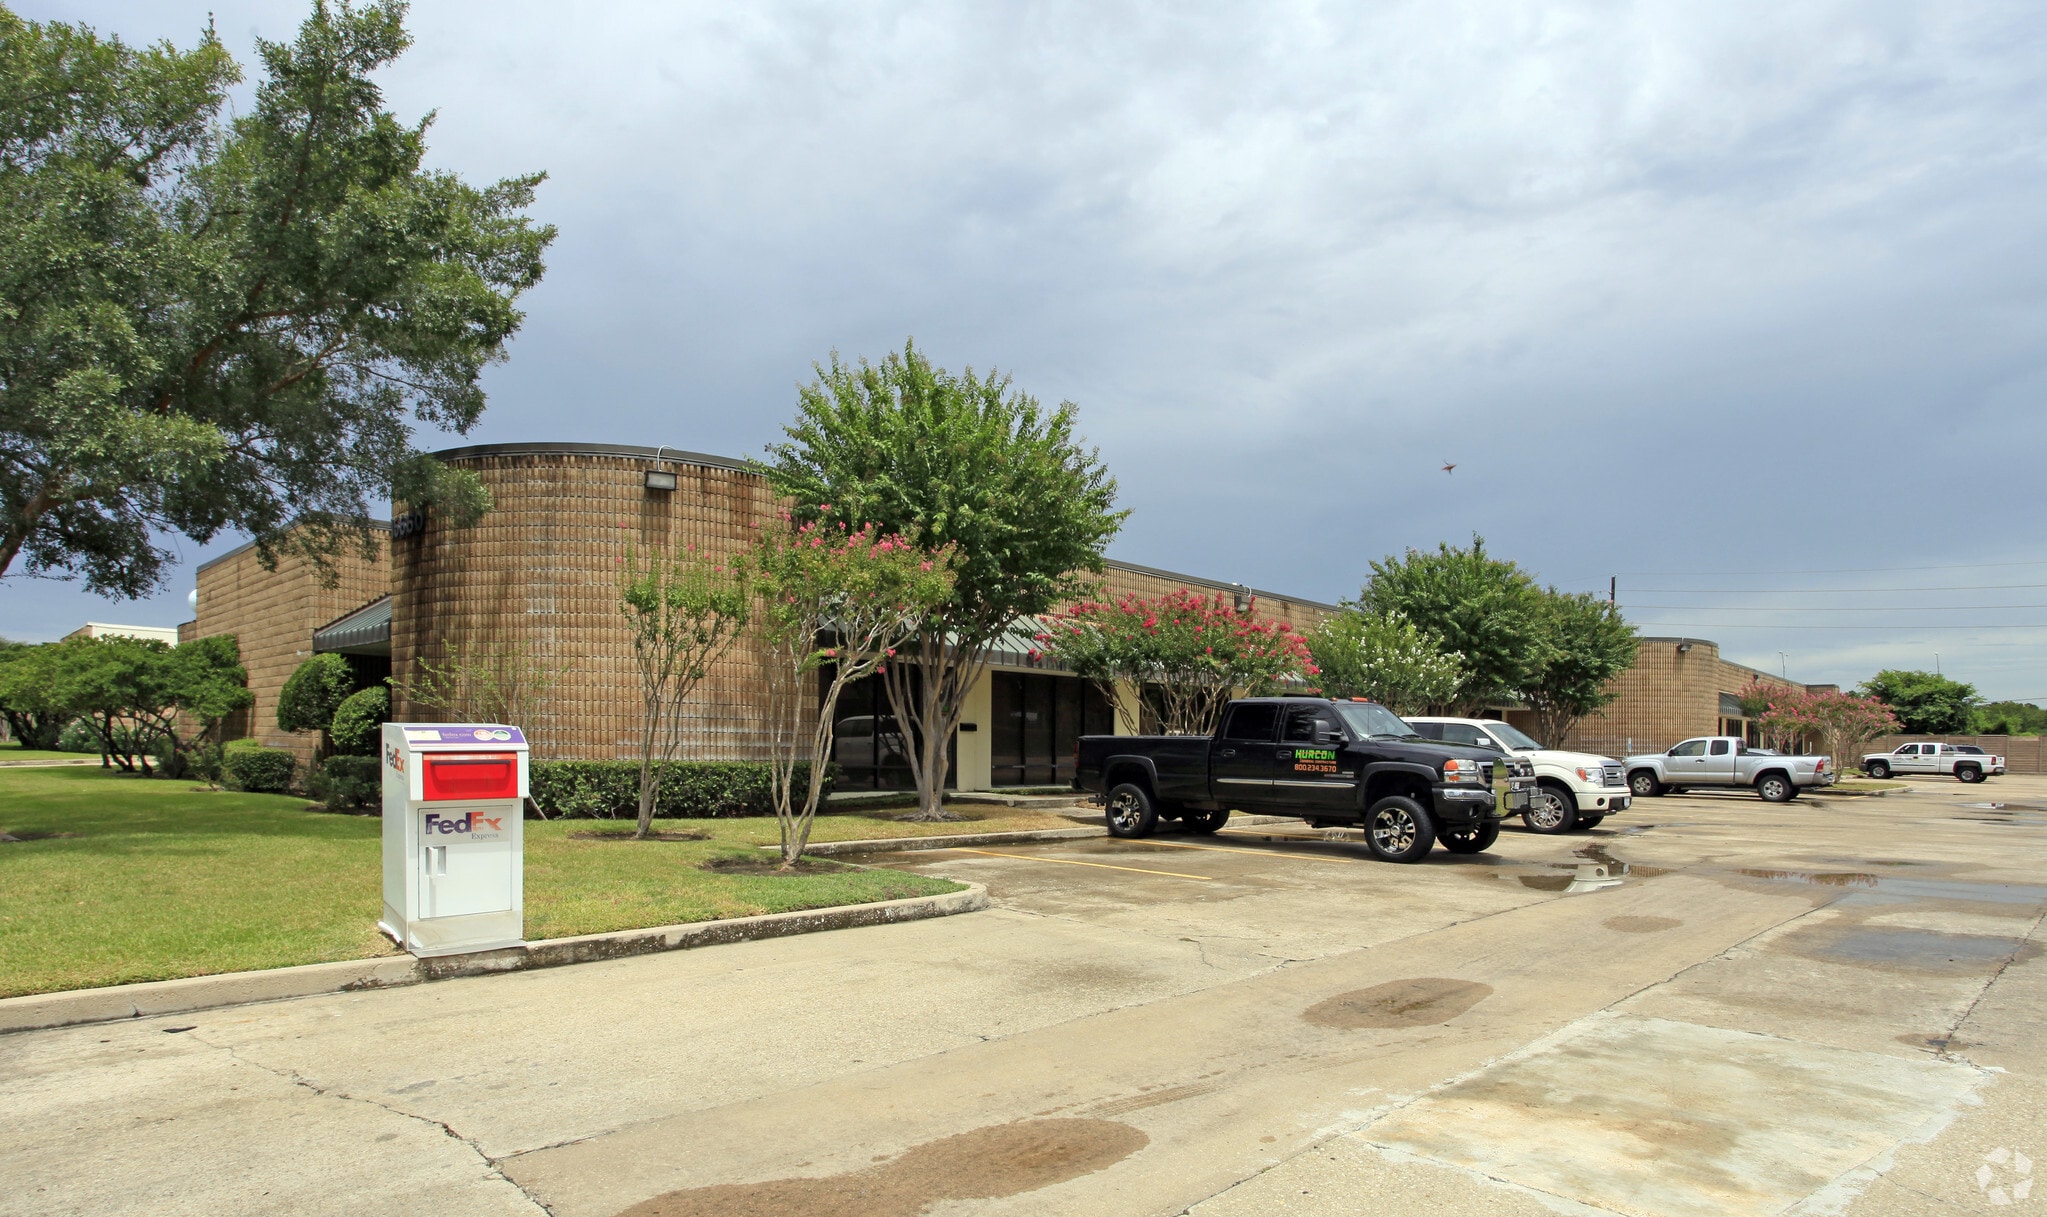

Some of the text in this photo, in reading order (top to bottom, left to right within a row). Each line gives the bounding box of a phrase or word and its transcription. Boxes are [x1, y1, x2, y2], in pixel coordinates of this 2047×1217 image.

[385, 743, 405, 773] FedEx
[1295, 749, 1335, 759] HURCON
[1294, 763, 1336, 772] 800.234.3670
[426, 812, 502, 834] FedEx
[471, 832, 499, 840] Express
